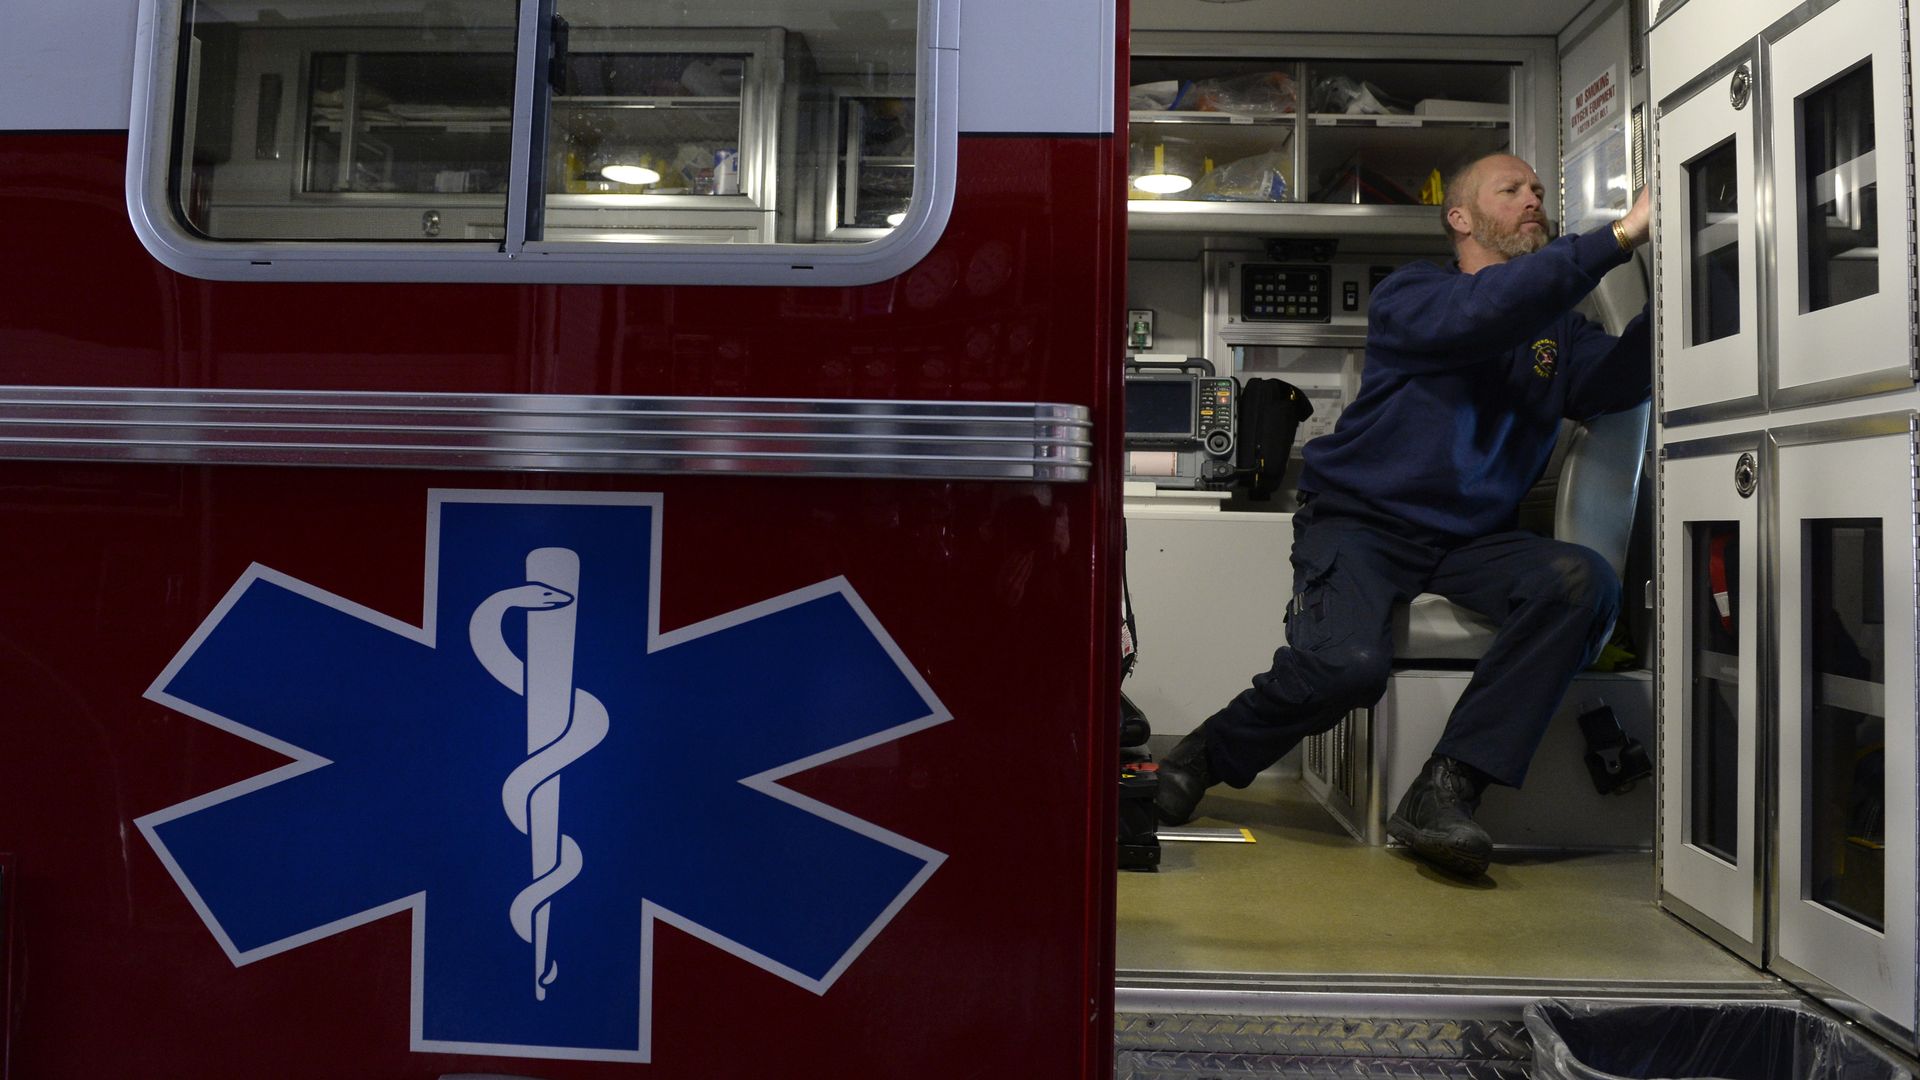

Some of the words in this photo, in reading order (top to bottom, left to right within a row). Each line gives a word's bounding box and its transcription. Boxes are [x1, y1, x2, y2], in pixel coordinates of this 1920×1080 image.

[1571, 105, 1588, 128] OXYGEN
[1589, 85, 1615, 114] EQUIPMENT
[1576, 93, 1583, 110] NO
[1584, 72, 1609, 103] SMOKING
